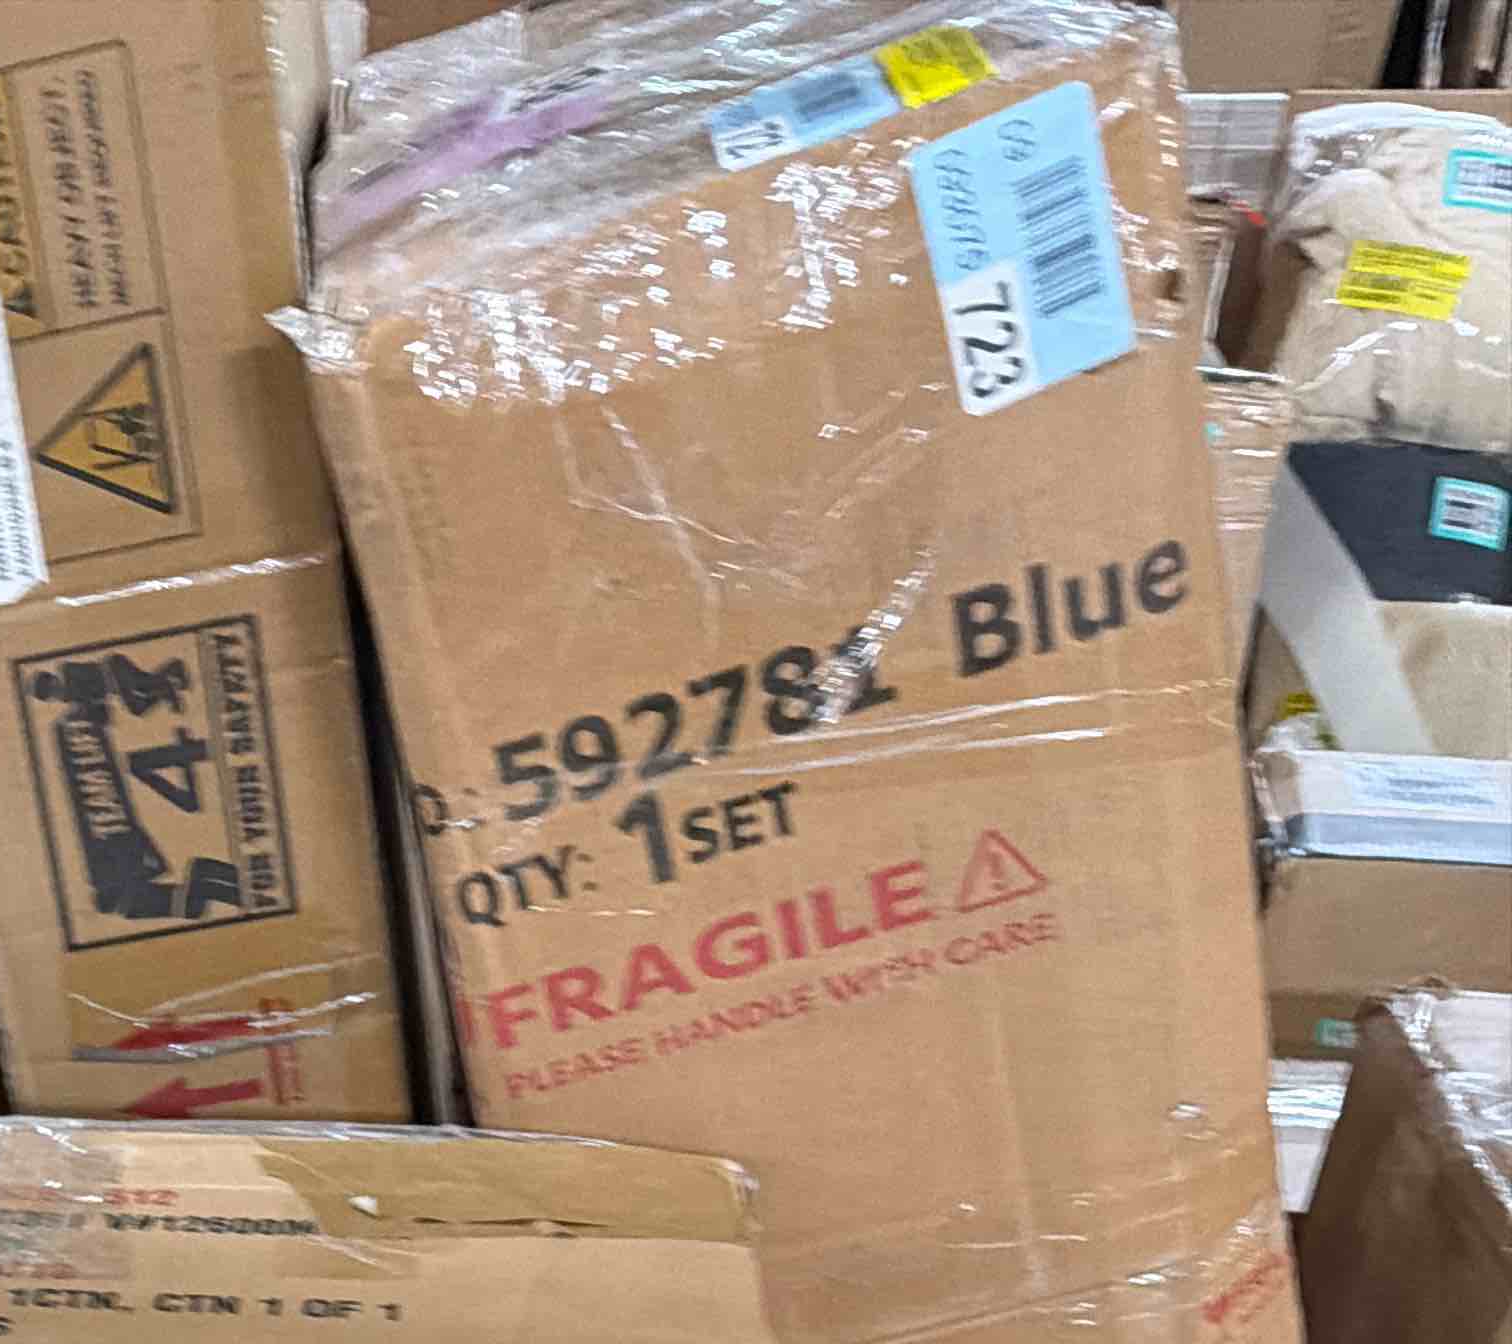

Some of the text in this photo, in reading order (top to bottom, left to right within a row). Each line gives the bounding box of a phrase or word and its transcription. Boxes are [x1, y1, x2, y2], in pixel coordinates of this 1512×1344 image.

[491, 624, 896, 820] 592781
[950, 539, 1190, 679] Blue
[126, 725, 215, 814] 4
[455, 844, 600, 927] QTY:
[489, 859, 937, 1052] FRAGILE
[504, 1038, 645, 1099] PLEASE
[656, 987, 819, 1054] HANDLE
[943, 912, 1059, 969] CARE
[152, 1291, 241, 1315] CTN
[299, 1298, 362, 1319] OF
